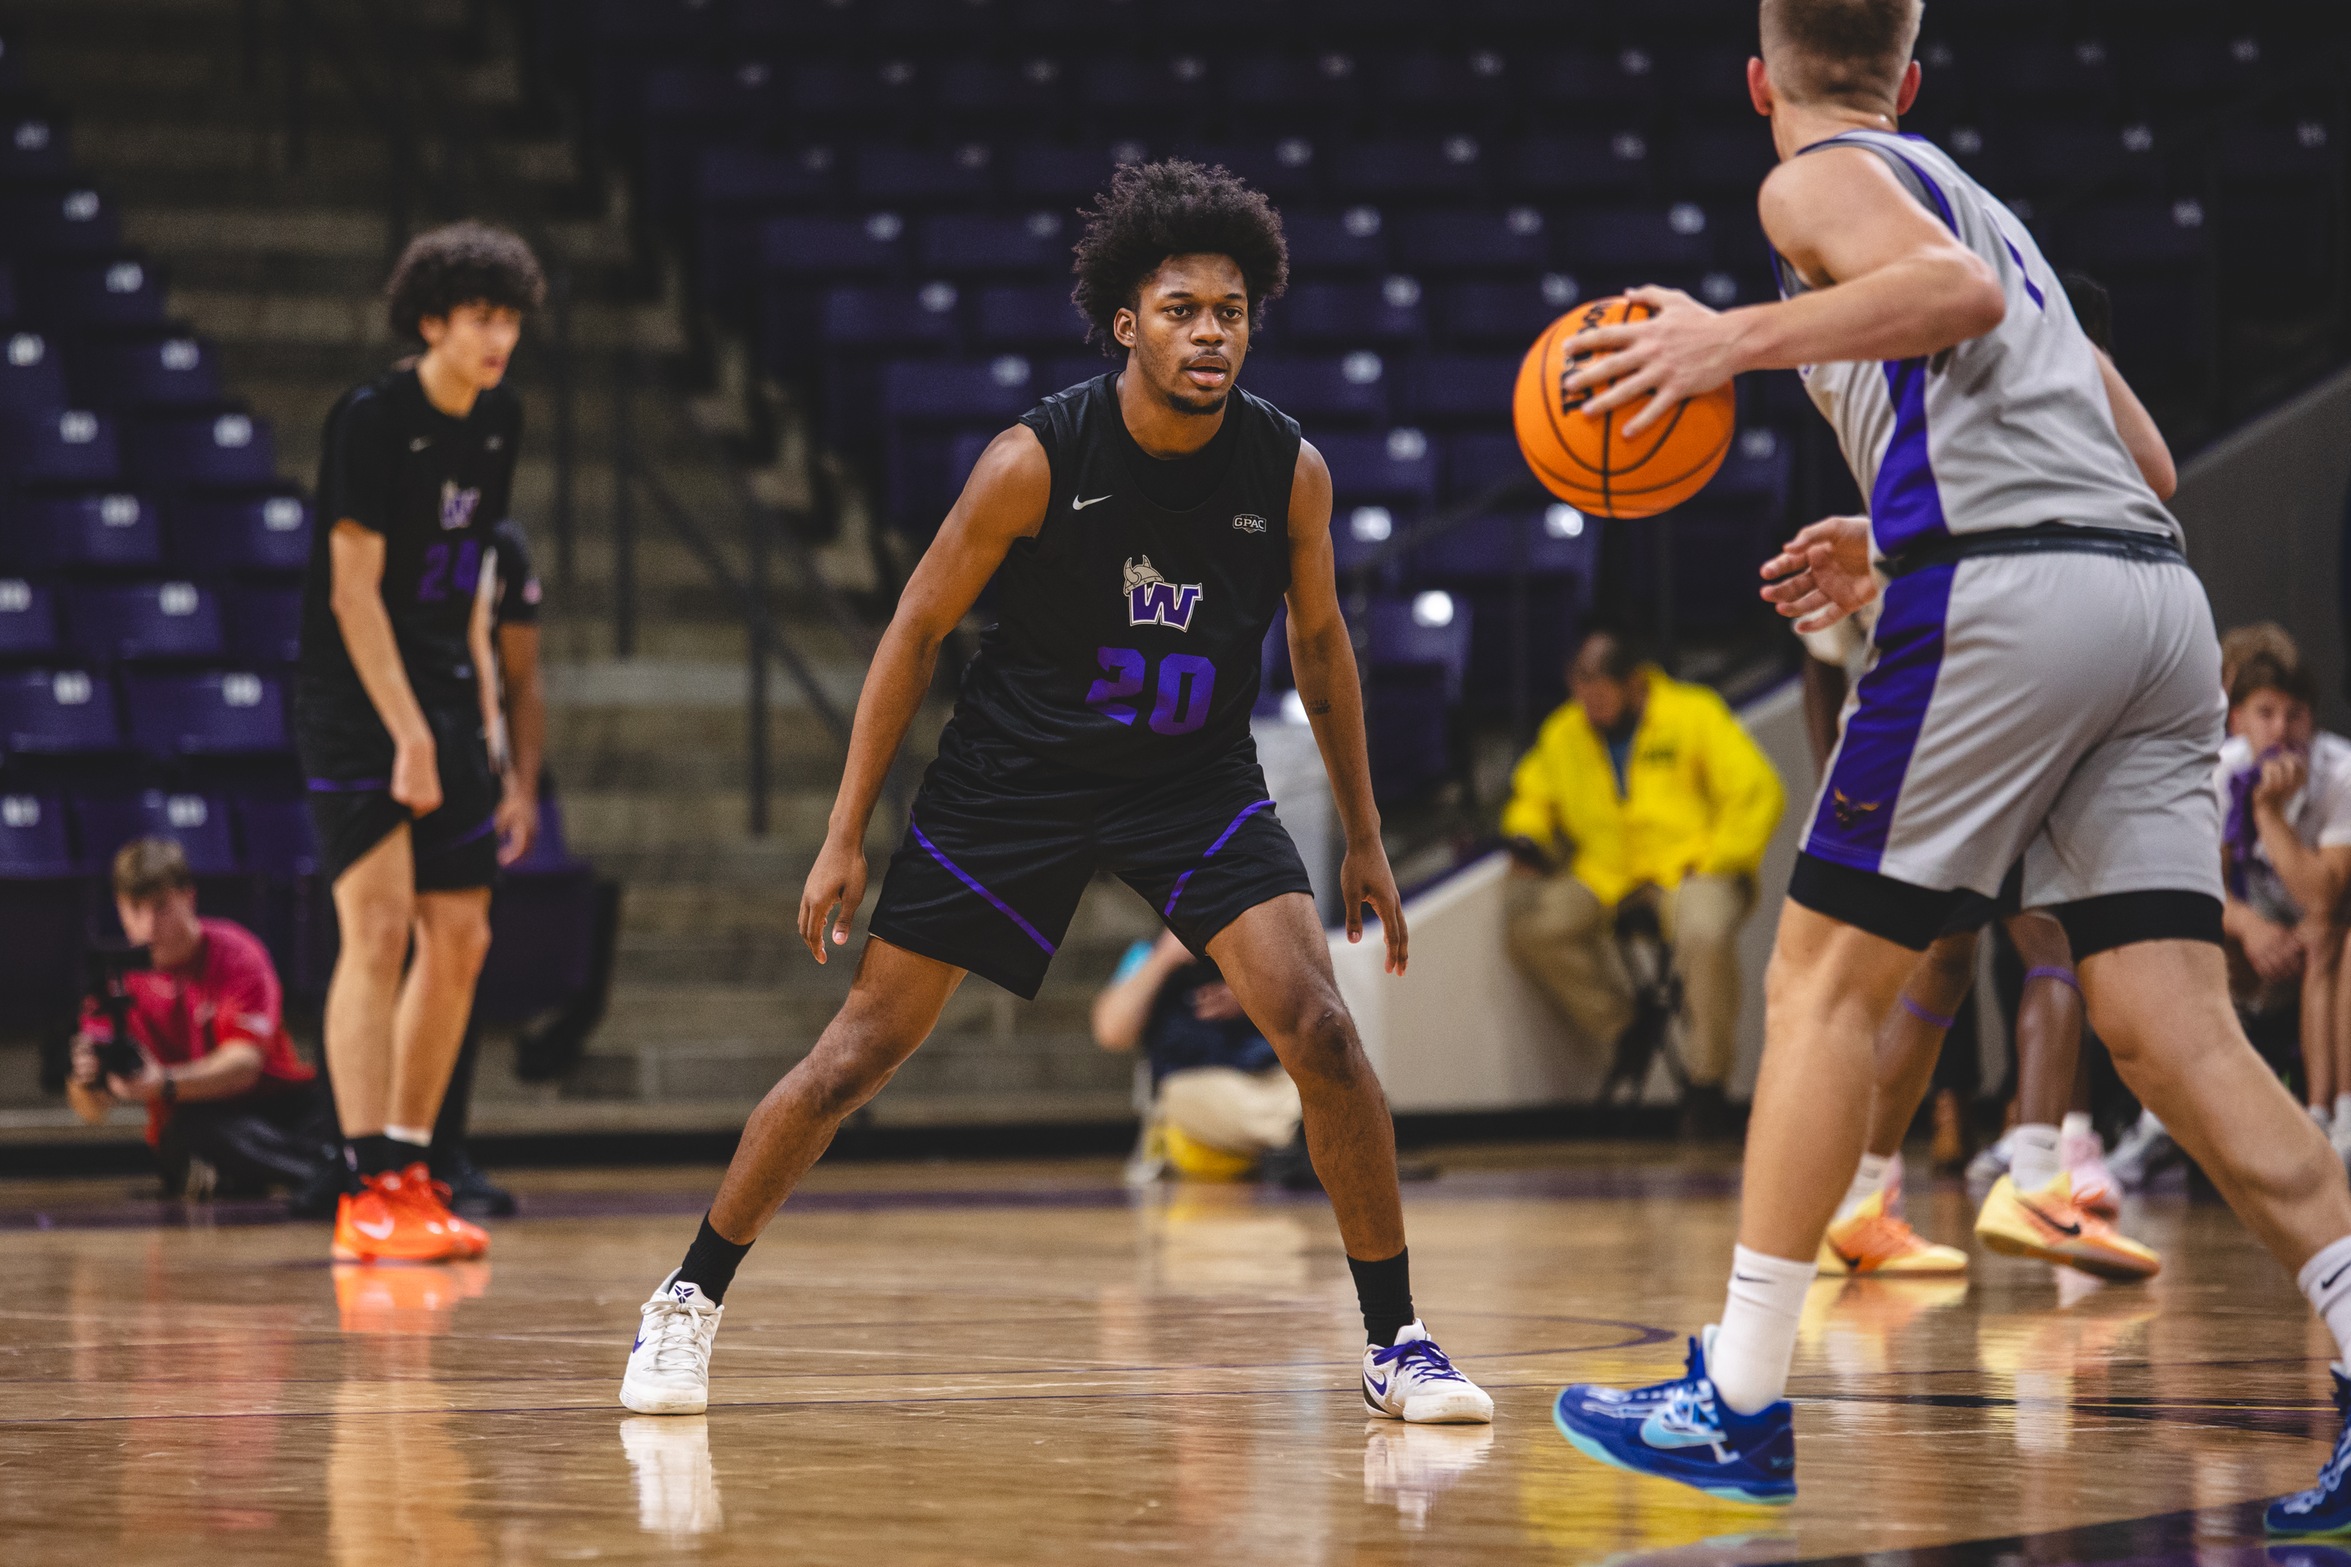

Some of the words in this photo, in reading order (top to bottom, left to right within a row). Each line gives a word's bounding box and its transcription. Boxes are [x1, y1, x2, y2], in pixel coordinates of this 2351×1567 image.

[1234, 517, 1265, 530] GPAC
[1130, 582, 1203, 632] W
[1085, 646, 1216, 736] 20
